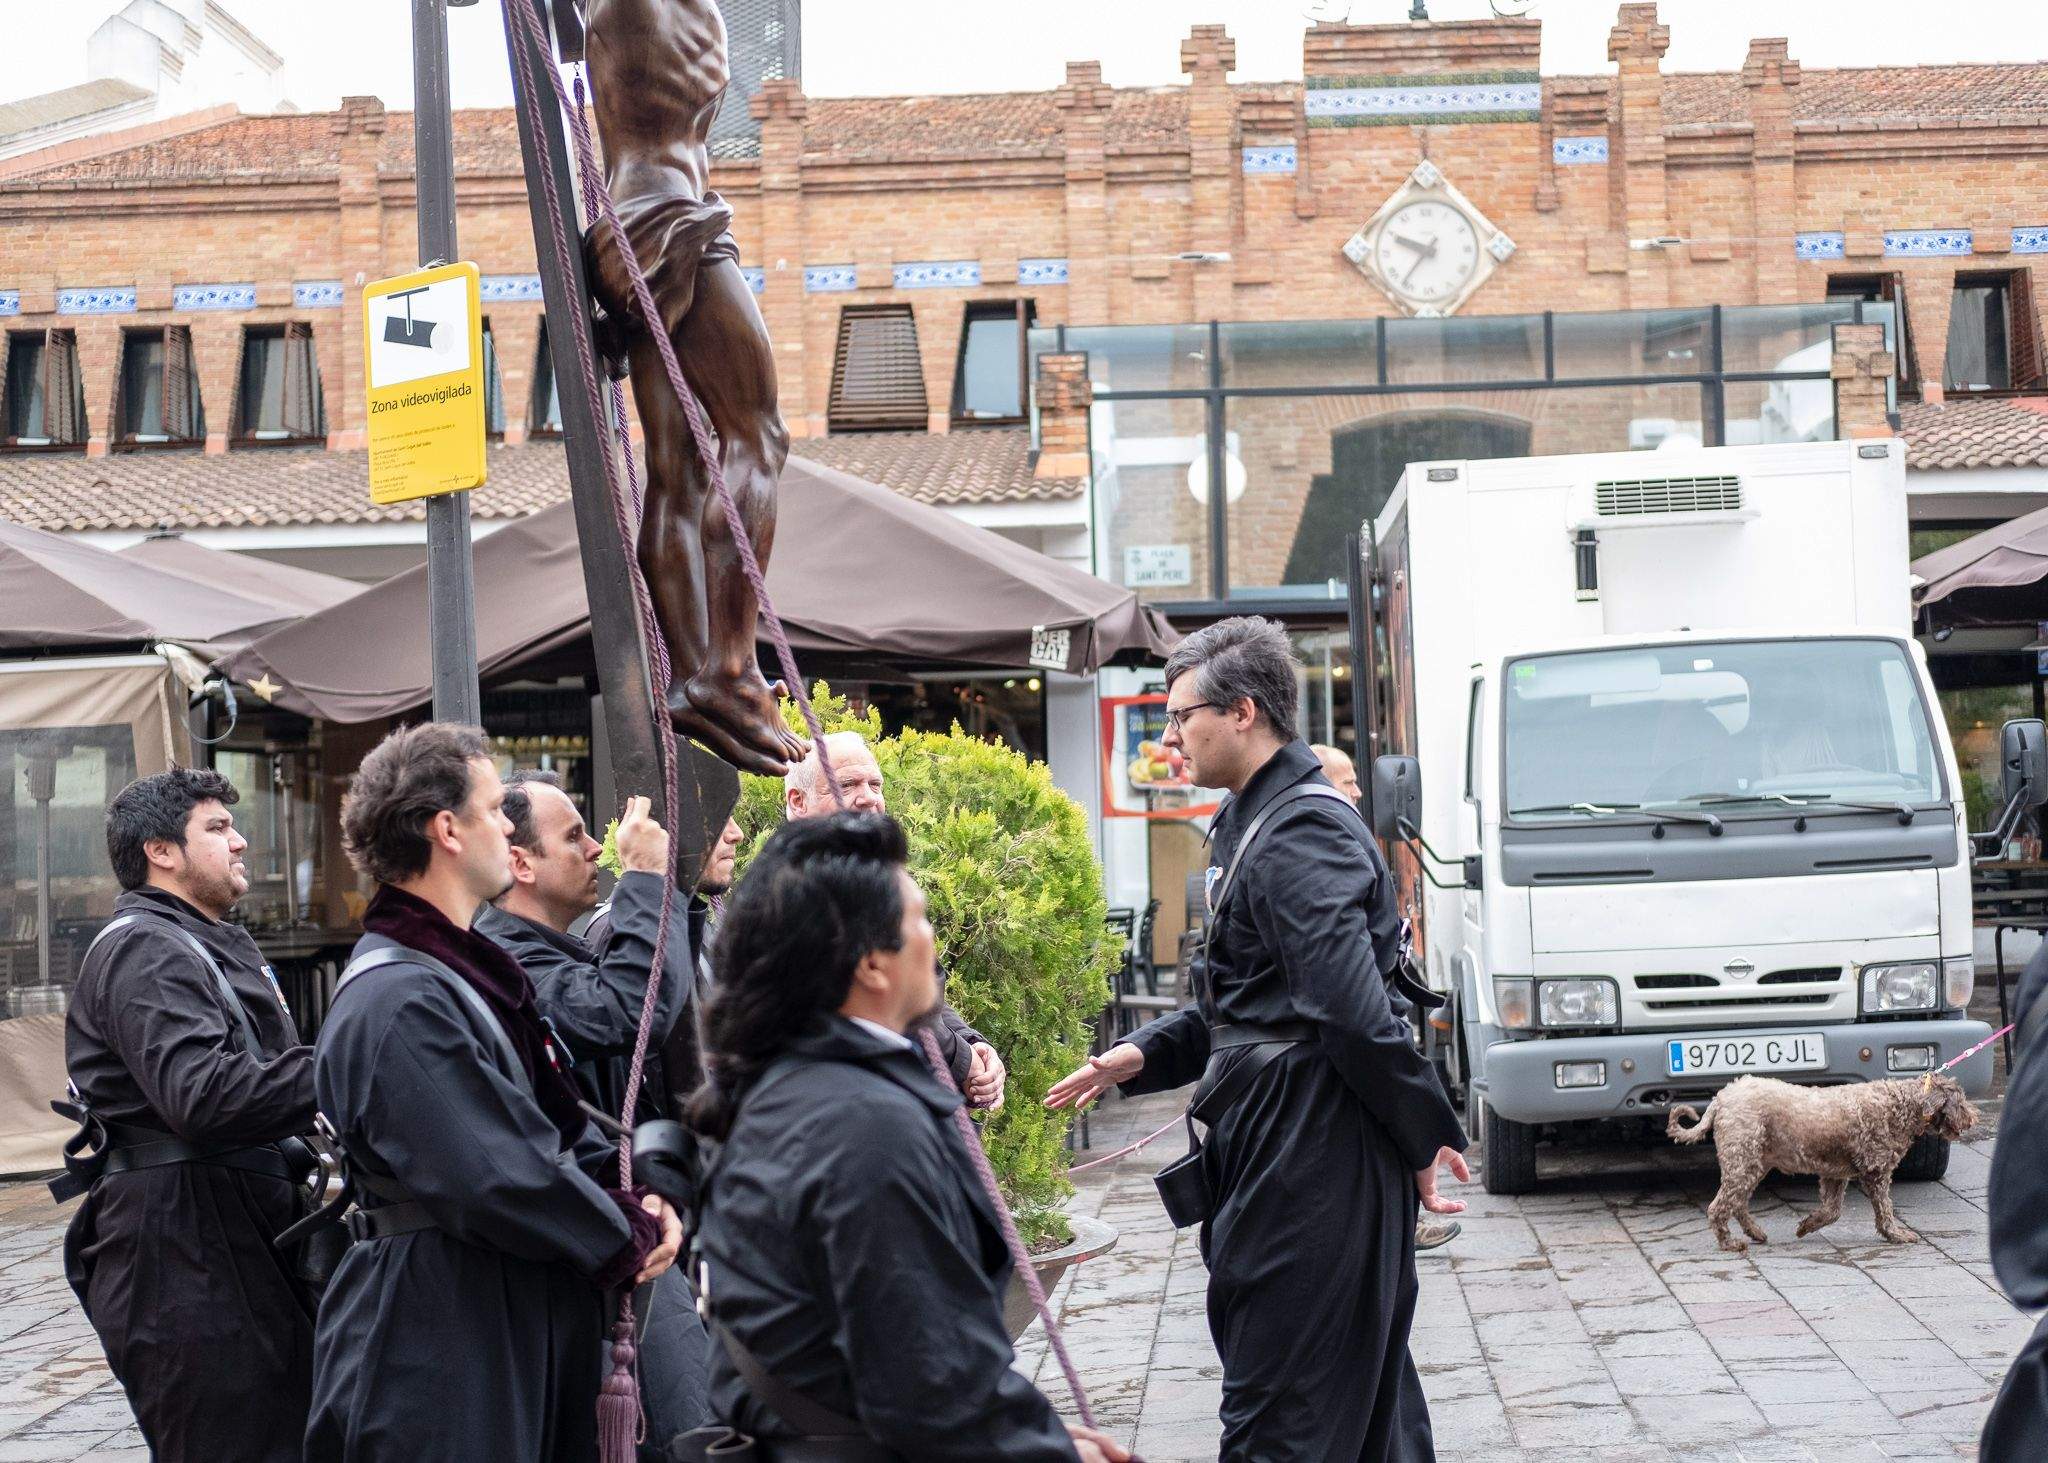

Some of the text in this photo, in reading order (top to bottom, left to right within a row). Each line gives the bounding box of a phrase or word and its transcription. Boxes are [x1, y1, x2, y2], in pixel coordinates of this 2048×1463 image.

[371, 383, 472, 414] Zona videovigilada
[1031, 630, 1070, 645] MER
[1031, 641, 1069, 662] CAT
[1688, 1042, 1757, 1068] 9702
[1766, 1038, 1818, 1065] CJL
